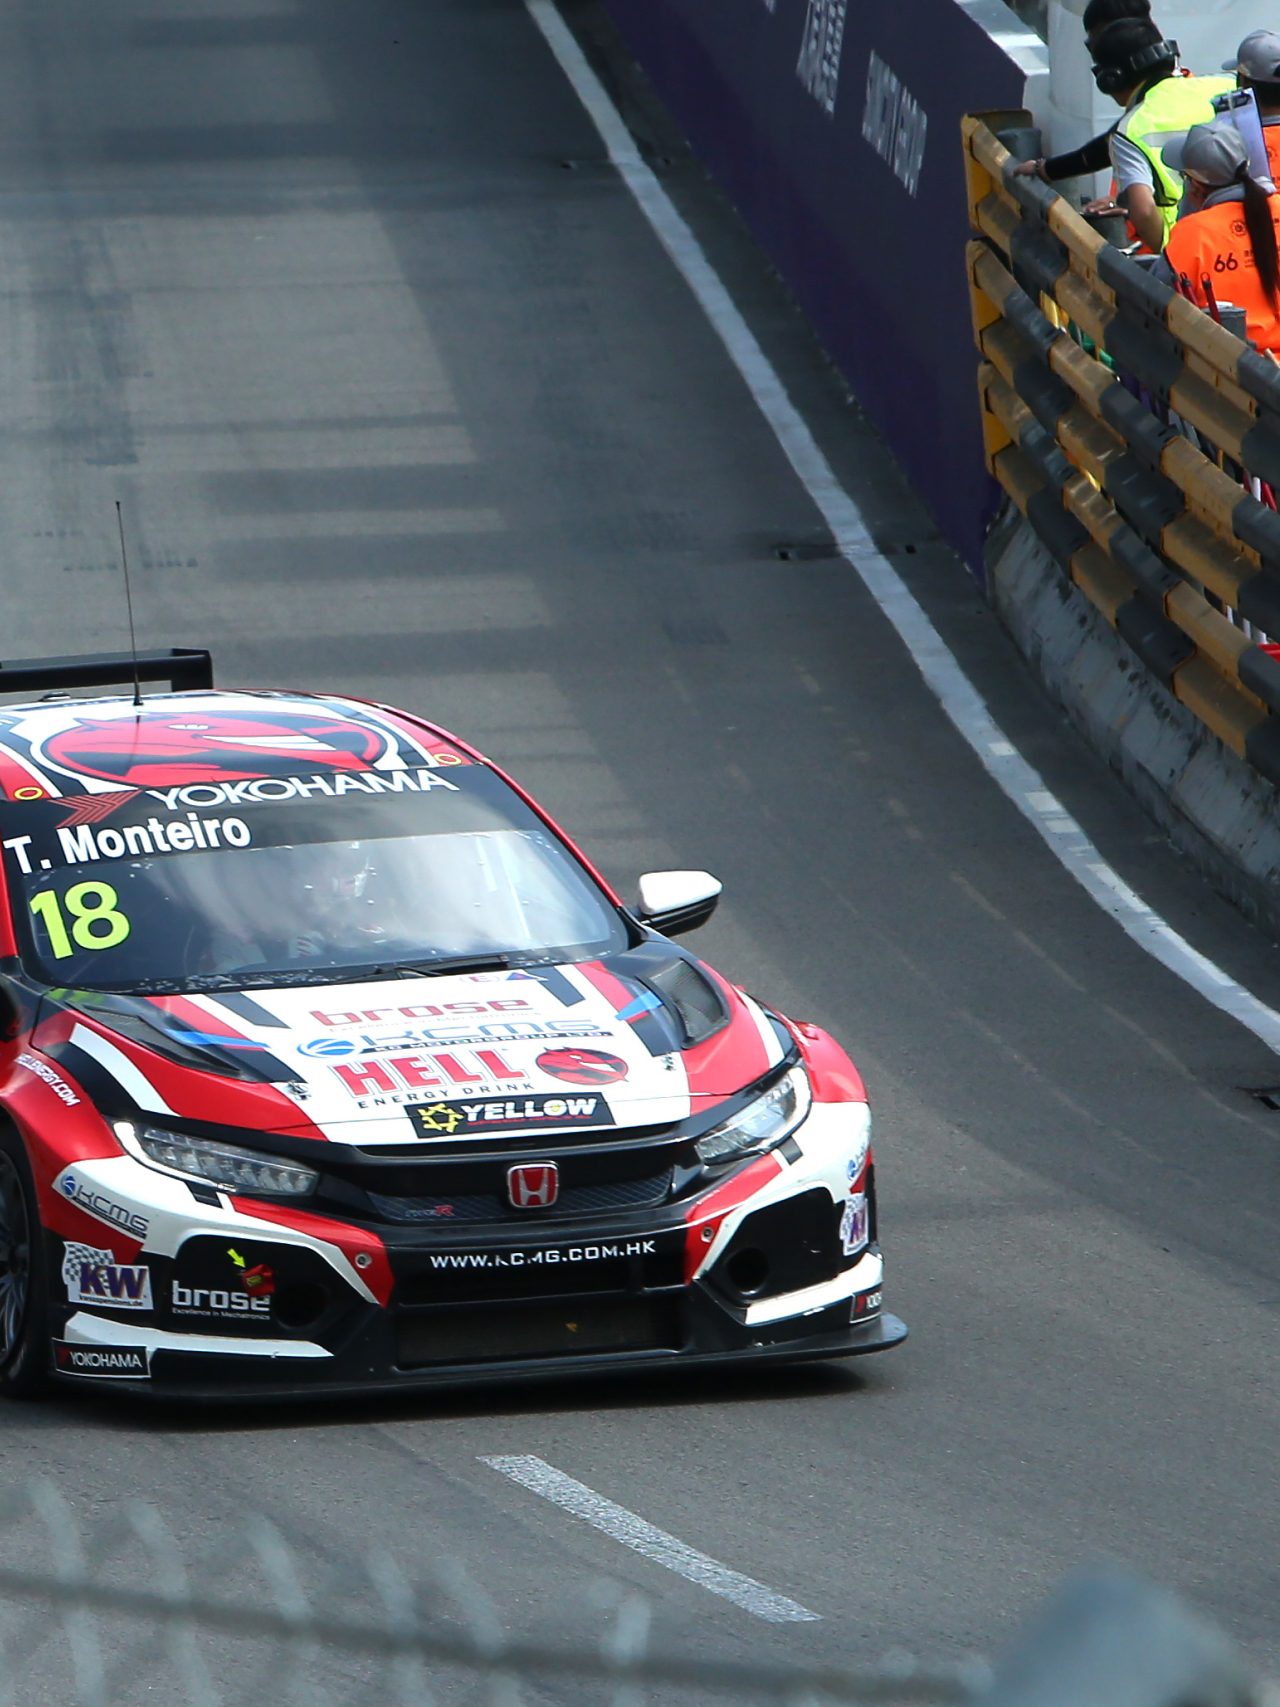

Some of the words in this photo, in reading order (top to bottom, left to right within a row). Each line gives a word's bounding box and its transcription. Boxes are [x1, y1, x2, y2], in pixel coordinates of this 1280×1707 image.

[1213, 252, 1239, 273] 66
[145, 769, 460, 812] YOKOHAMA
[3, 835, 53, 875] T.
[57, 811, 251, 867] Monteiro
[28, 880, 131, 961] 18
[309, 999, 534, 1027] brose
[360, 1019, 601, 1047] KCMG
[328, 1049, 530, 1098] HELL
[357, 1089, 449, 1110] ENERGY
[462, 1081, 535, 1095] DRINK
[460, 1098, 597, 1122] YELLOW
[76, 1184, 150, 1234] KCMG
[80, 1262, 147, 1299] KW
[172, 1279, 271, 1311] brose
[69, 1352, 142, 1369] YOKOHAMA
